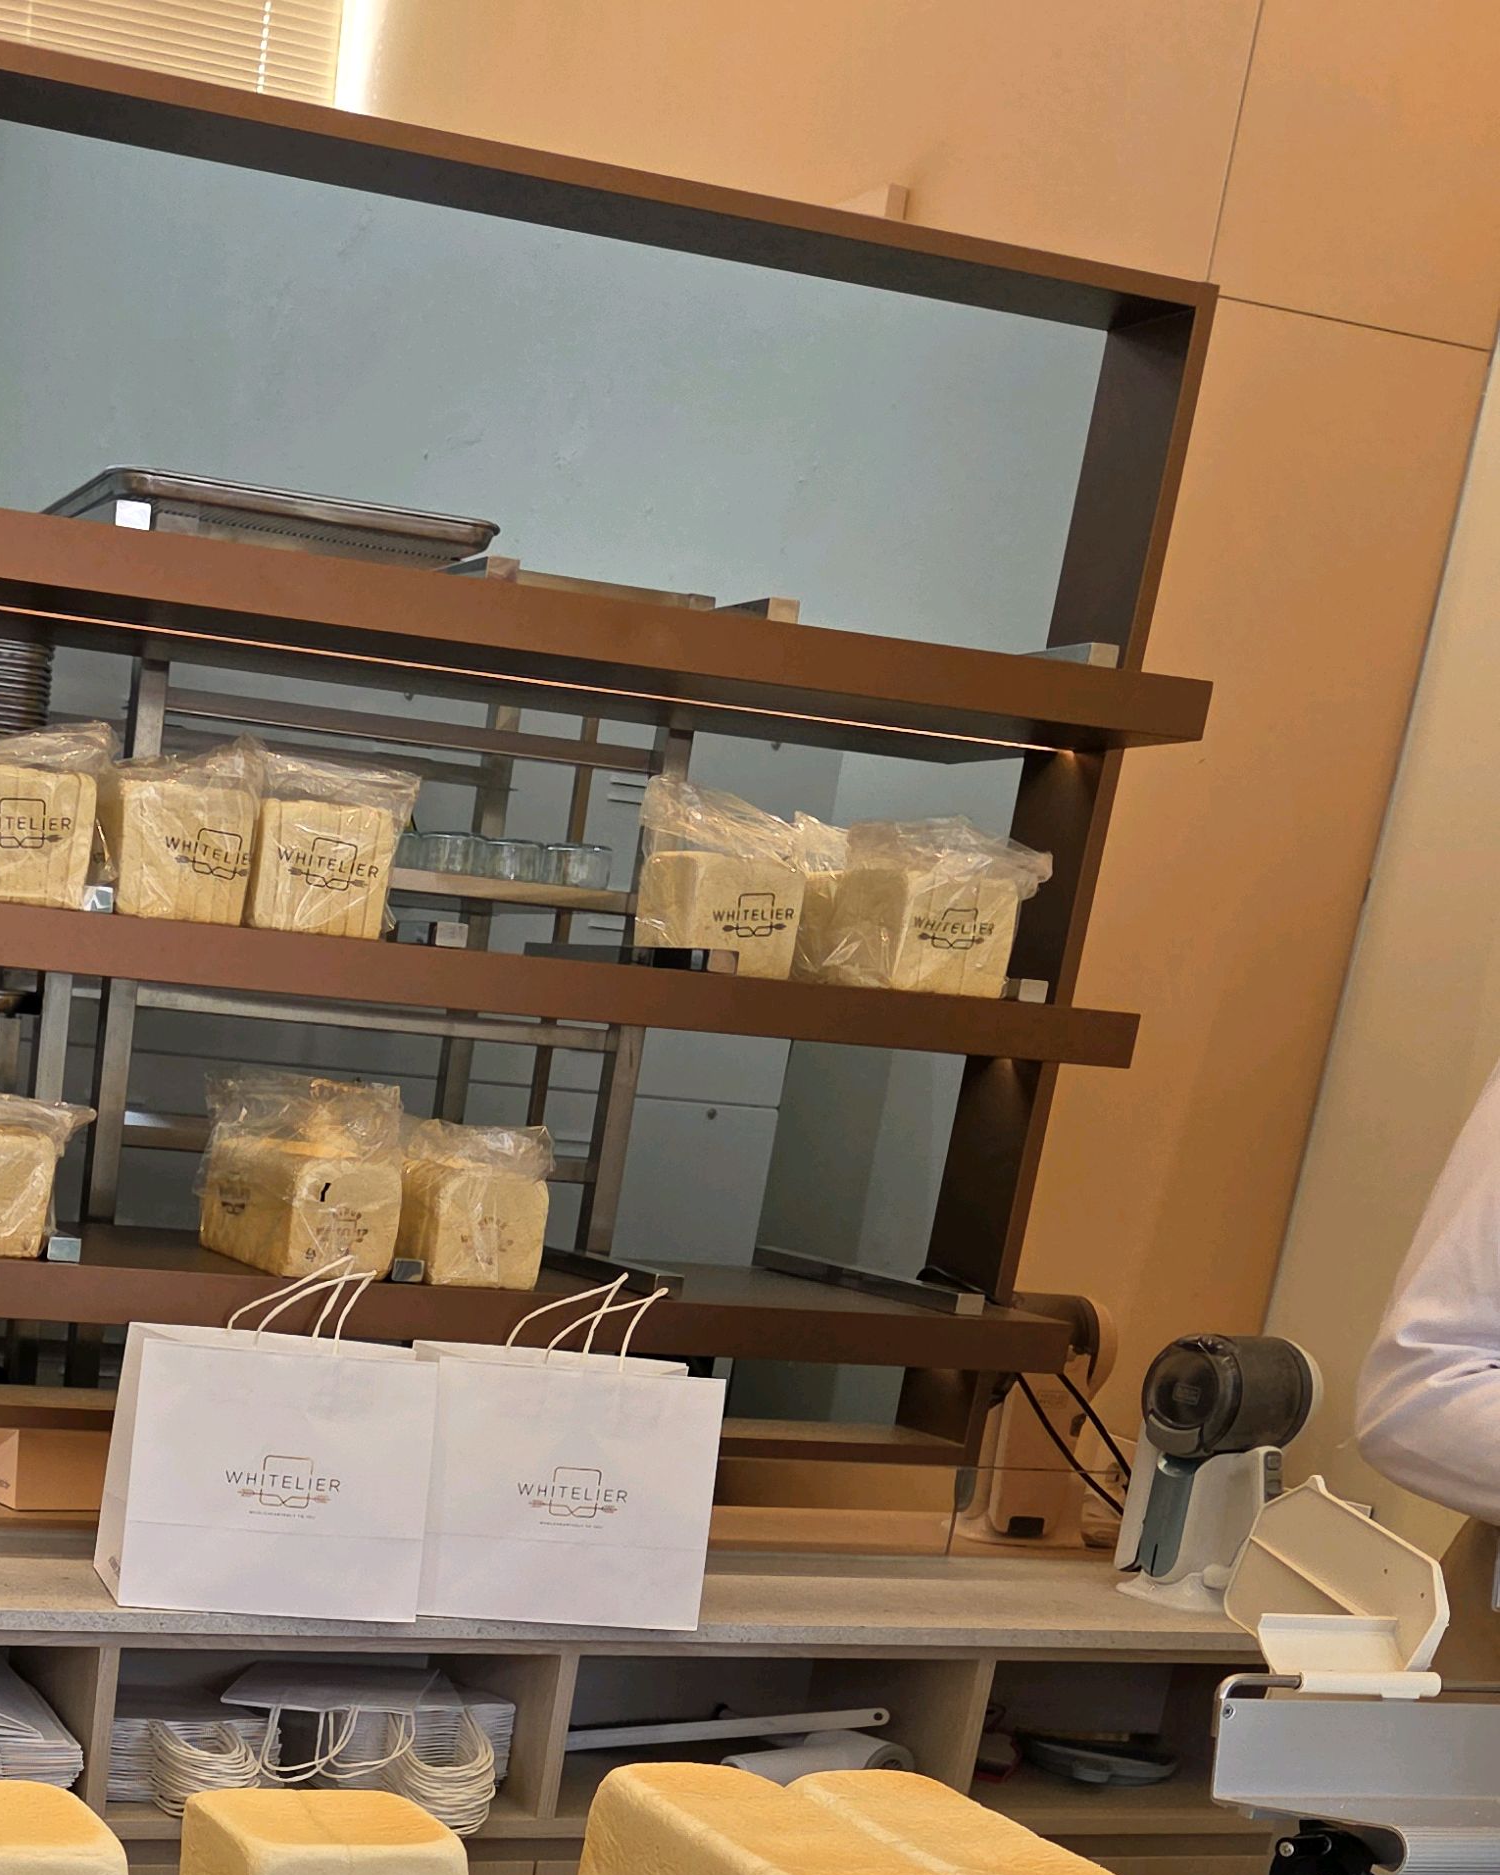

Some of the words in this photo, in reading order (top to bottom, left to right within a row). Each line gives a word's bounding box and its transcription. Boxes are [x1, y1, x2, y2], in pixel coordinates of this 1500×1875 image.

[165, 836, 250, 865] WHITELIE
[277, 847, 379, 878] WHITELIER
[712, 907, 795, 922] WHITELIER
[914, 915, 995, 936] WHITELIER
[225, 1470, 341, 1493] WHITELIER
[517, 1482, 629, 1503] WHITELIER
